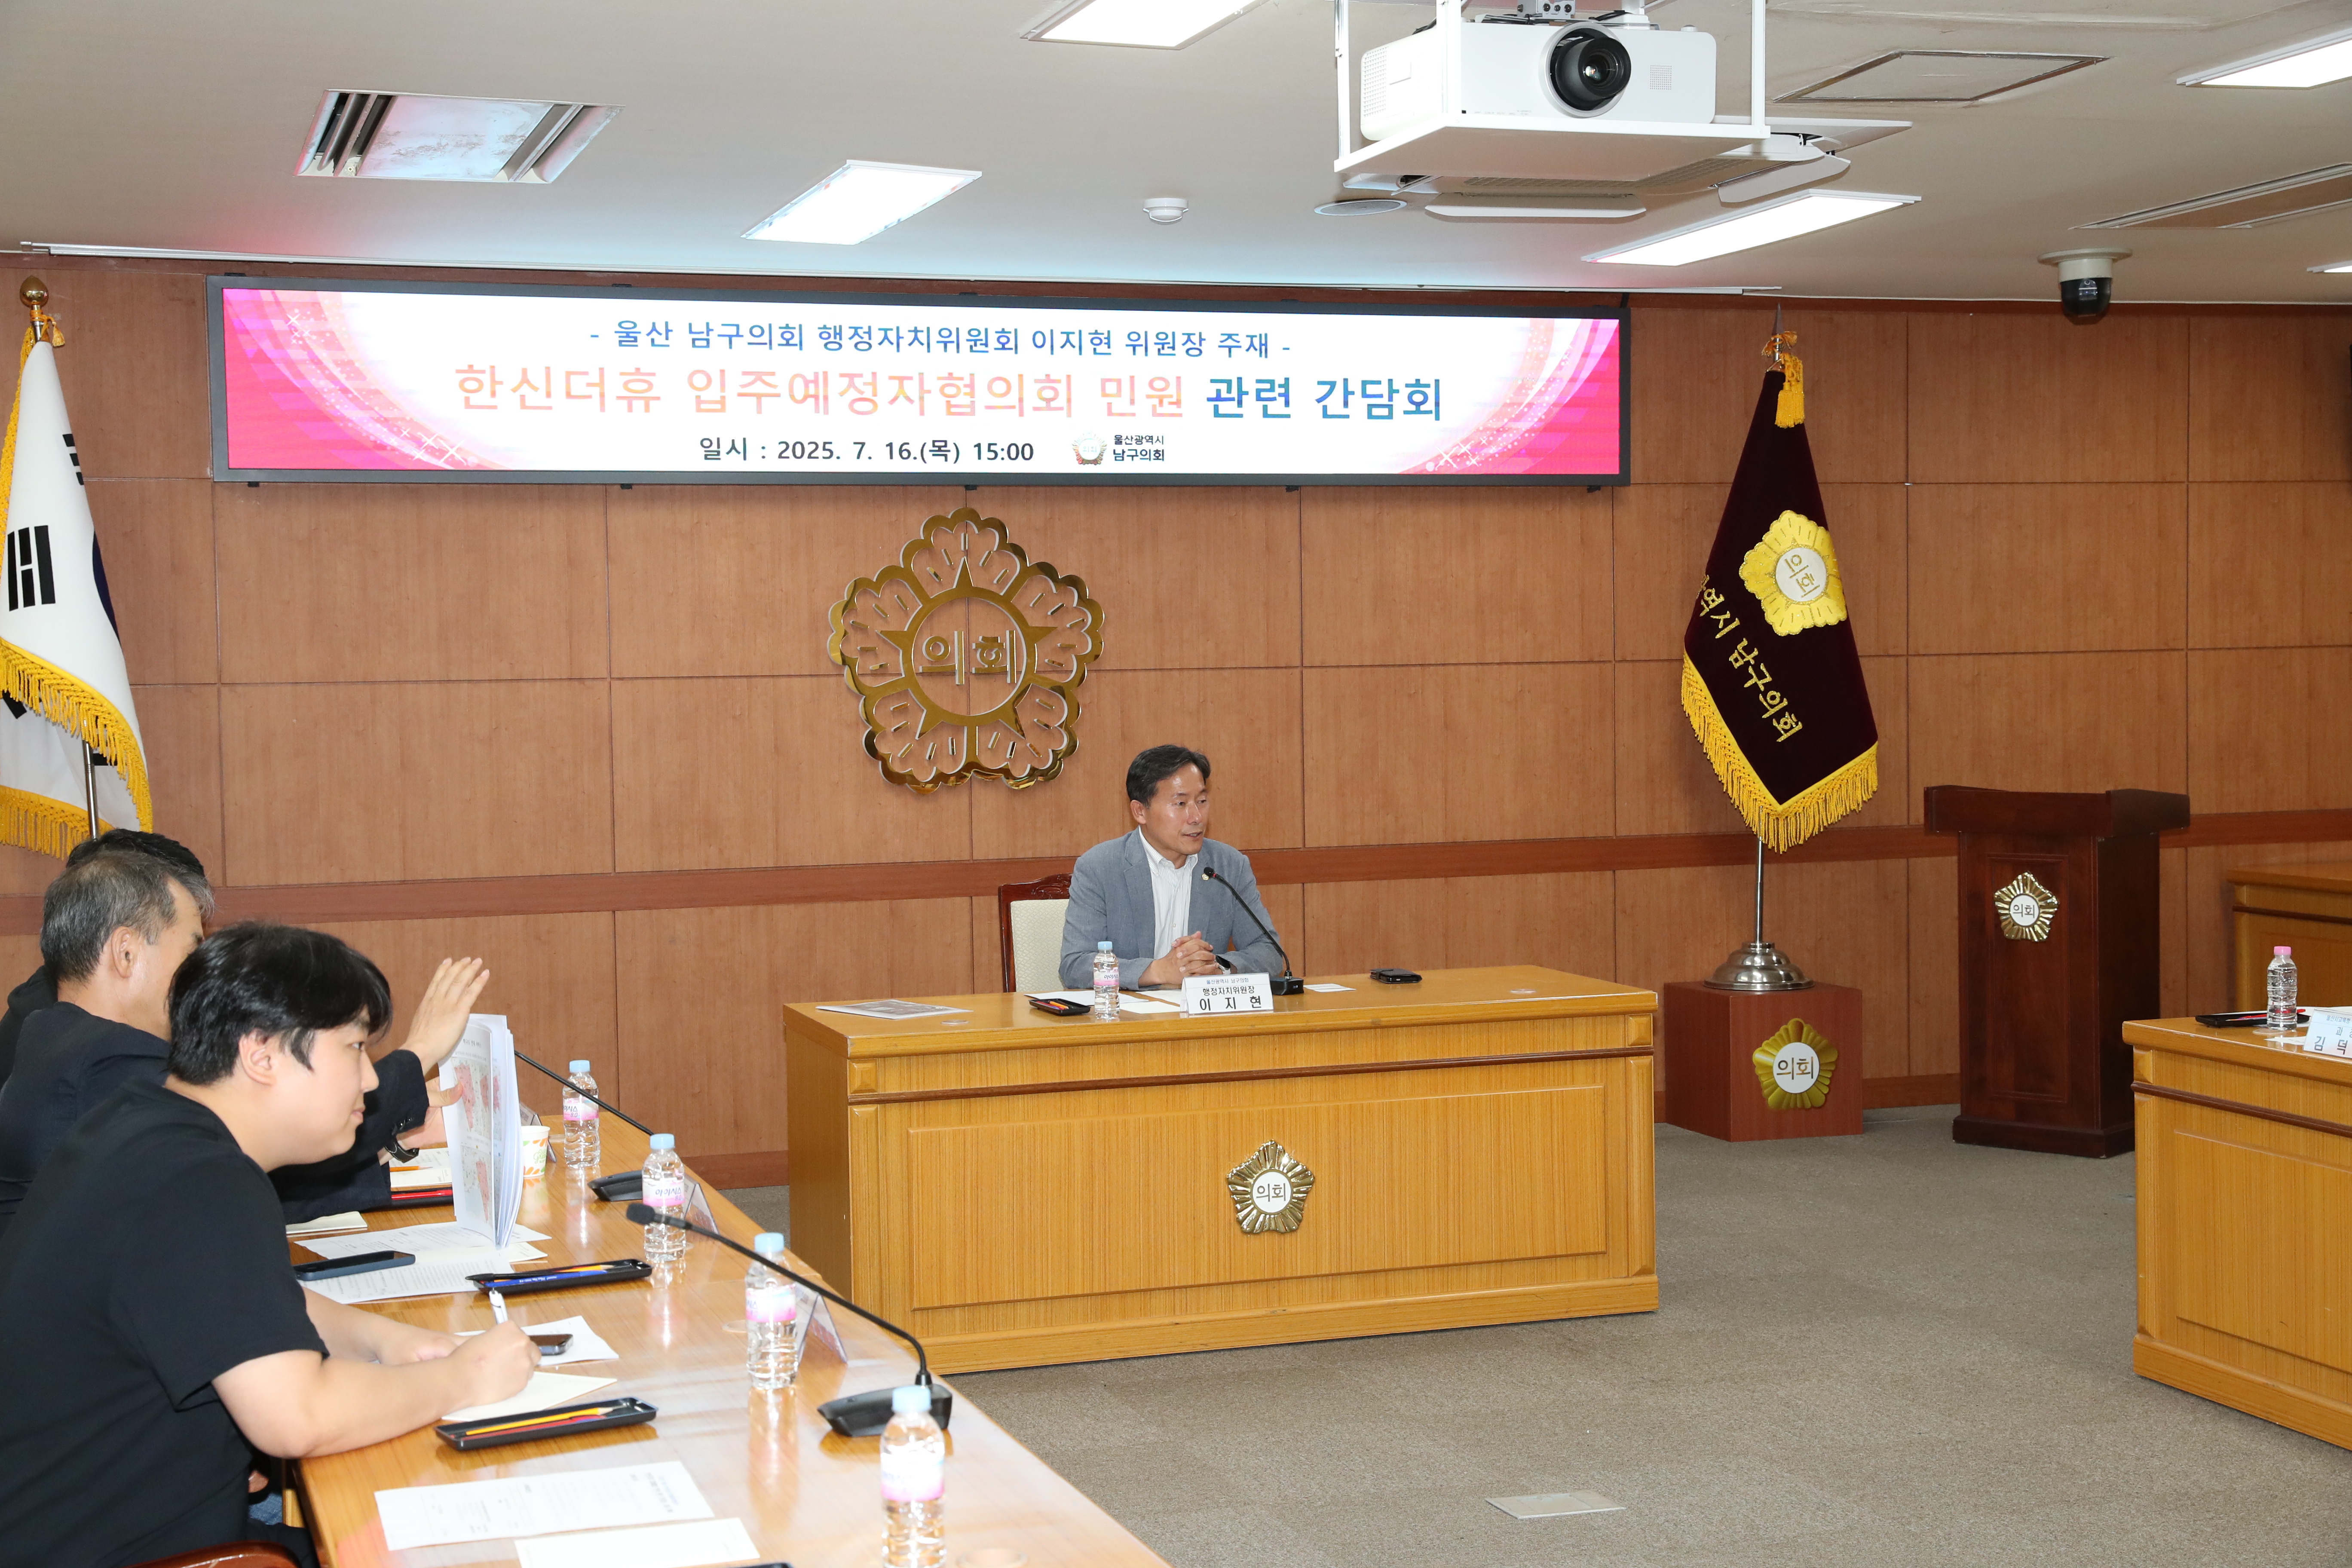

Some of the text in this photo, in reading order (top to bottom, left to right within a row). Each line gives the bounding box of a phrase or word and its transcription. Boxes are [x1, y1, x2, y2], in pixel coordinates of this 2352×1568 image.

[614, 320, 674, 347] 울산
[688, 322, 803, 351] 남구의회
[817, 324, 1019, 355] 행정자치위원회
[1032, 328, 1112, 356] 이지현
[1125, 330, 1206, 358] 위원장
[1218, 332, 1268, 358] 주재
[455, 364, 1440, 421] 한신더휴 입주예정자협의회 민원 관련 간담회
[700, 437, 747, 462] 일시
[778, 441, 841, 460] 2025.
[852, 441, 873, 460] 7.
[885, 439, 960, 465] 16.(목)
[973, 442, 1034, 461] 15:00
[1114, 435, 1164, 445] 울산광역시
[1113, 448, 1164, 462] 남구의회
[1784, 554, 1820, 597] 의회
[919, 630, 1017, 685] 의회
[1729, 637, 1803, 742] 남구의회
[2013, 903, 2035, 918] 의회
[1203, 986, 1255, 996] 행정자치위원장
[1776, 1056, 1813, 1080] 의회
[1256, 1183, 1286, 1202] 의회
